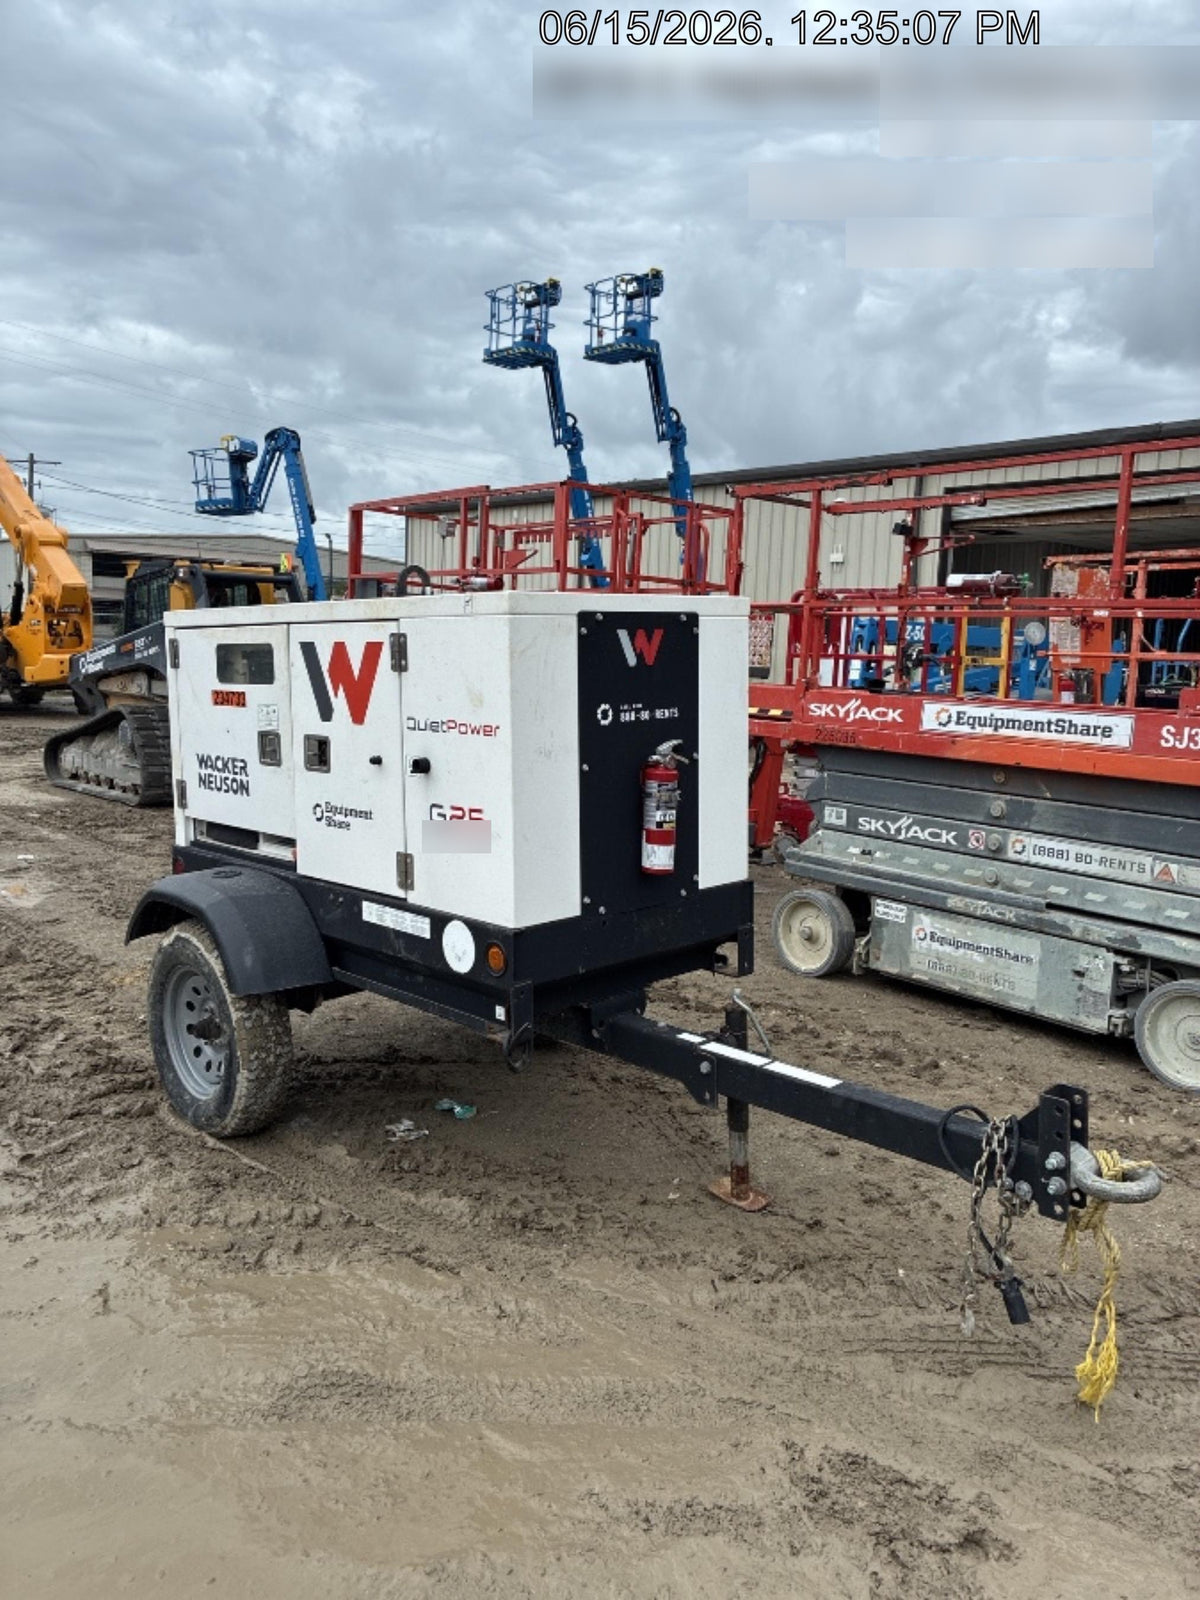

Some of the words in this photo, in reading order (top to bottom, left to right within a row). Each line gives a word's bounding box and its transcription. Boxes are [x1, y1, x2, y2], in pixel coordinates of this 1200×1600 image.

[808, 698, 904, 723] SKYJACK
[955, 710, 1114, 739] EquipmentShare
[195, 753, 249, 778] WACKER
[198, 772, 250, 797] NEUSON
[858, 816, 958, 846] SKYJACK
[929, 931, 1034, 965] EquipmentShare
